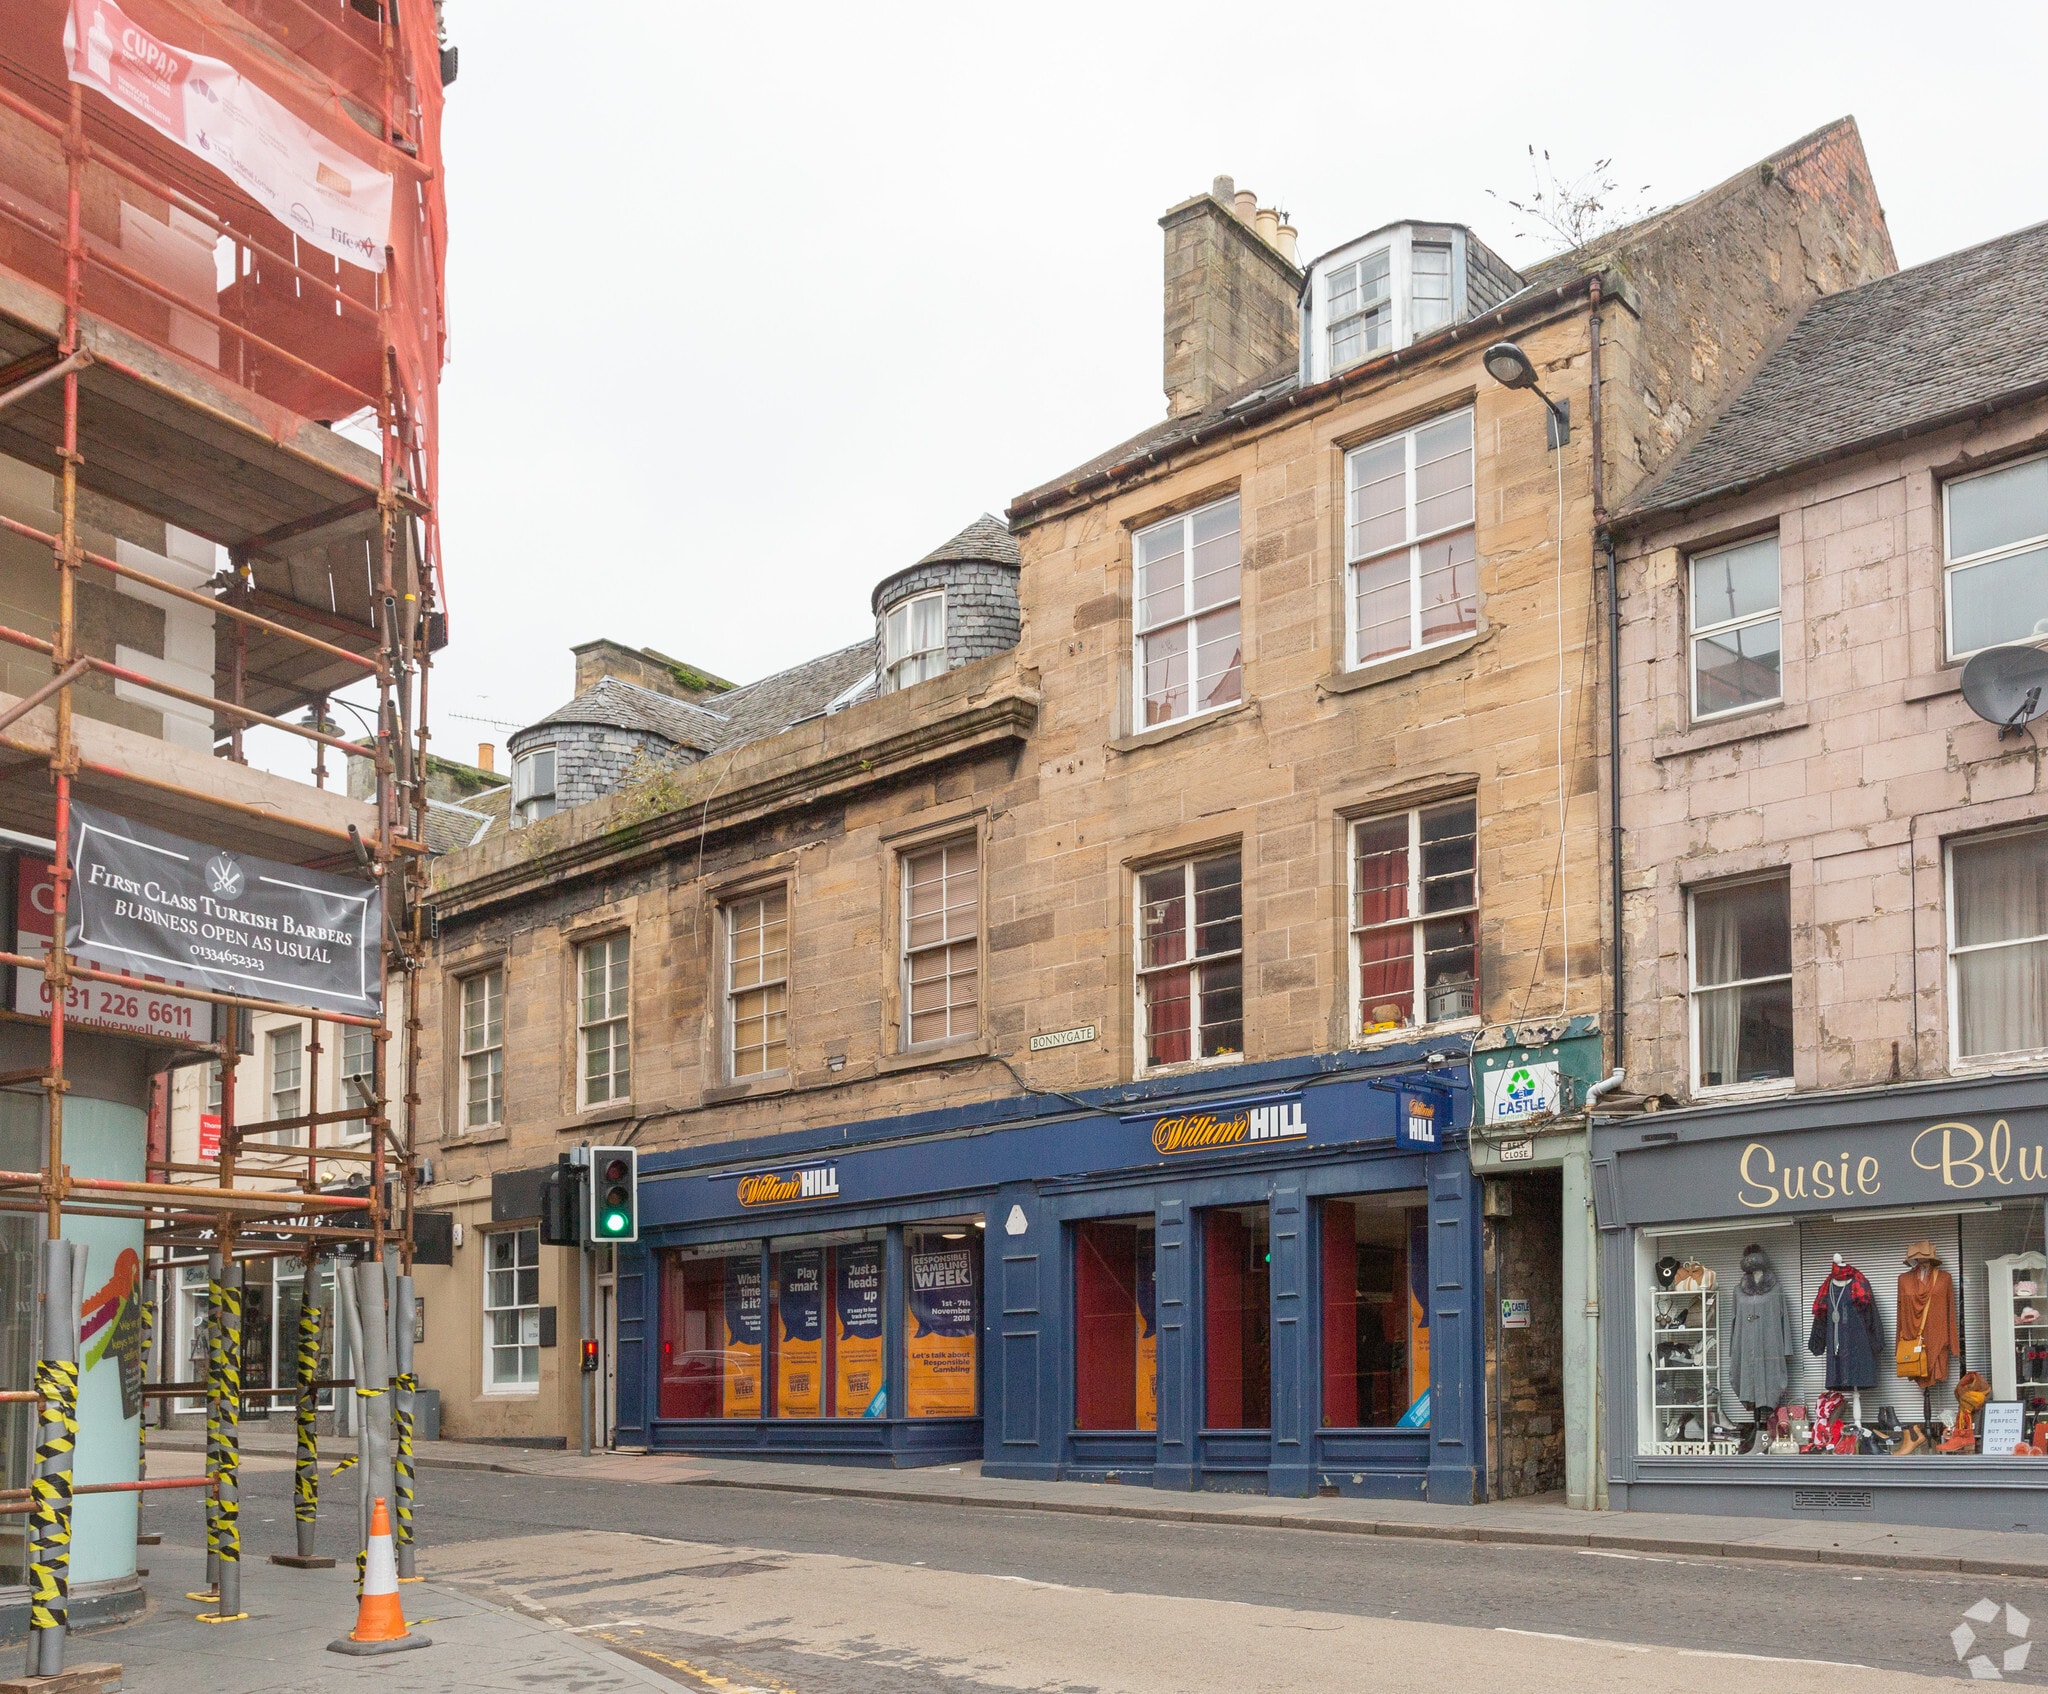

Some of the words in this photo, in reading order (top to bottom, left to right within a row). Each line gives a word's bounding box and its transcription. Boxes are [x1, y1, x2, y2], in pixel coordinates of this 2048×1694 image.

[122, 28, 178, 82] CUPAR
[331, 226, 354, 248] Fife
[114, 899, 198, 936] BUSINESS
[201, 923, 249, 947] OPEN
[251, 935, 272, 952] AS
[275, 939, 332, 964] USUAL
[189, 944, 265, 971] 01334652323
[40, 981, 90, 1010] 031
[100, 992, 139, 1018] 226
[148, 1000, 192, 1028] 6611
[1033, 1028, 1093, 1049] BONNYGATE
[1498, 1097, 1546, 1115] CASTLE
[1152, 1112, 1250, 1154] William
[1250, 1103, 1307, 1140] HILL
[1409, 1116, 1435, 1142] HILL
[1505, 1150, 1529, 1160] CLOSE
[1738, 1143, 1881, 1208] Susie
[737, 1171, 802, 1206] William
[802, 1167, 839, 1197] HILL
[914, 1253, 968, 1265] RESPONSIBLE
[848, 1264, 869, 1276] Just
[870, 1265, 878, 1274] a
[914, 1261, 968, 1273] GAMBLING
[737, 1273, 761, 1285] What
[797, 1267, 818, 1280] Play
[915, 1269, 969, 1288] WEEK
[789, 1281, 818, 1292] smart
[848, 1276, 878, 1289] heads
[741, 1286, 761, 1297] time
[864, 1291, 878, 1303] up
[741, 1299, 749, 1309] is
[749, 1298, 761, 1309] it?
[957, 1299, 971, 1307] 7th
[1512, 1303, 1530, 1311] CASTLE
[923, 1359, 970, 1367] Responsible
[933, 1366, 970, 1374] Gambling
[735, 1385, 754, 1395] WEEK
[790, 1383, 809, 1392] WEEK
[849, 1382, 869, 1392] WEEK
